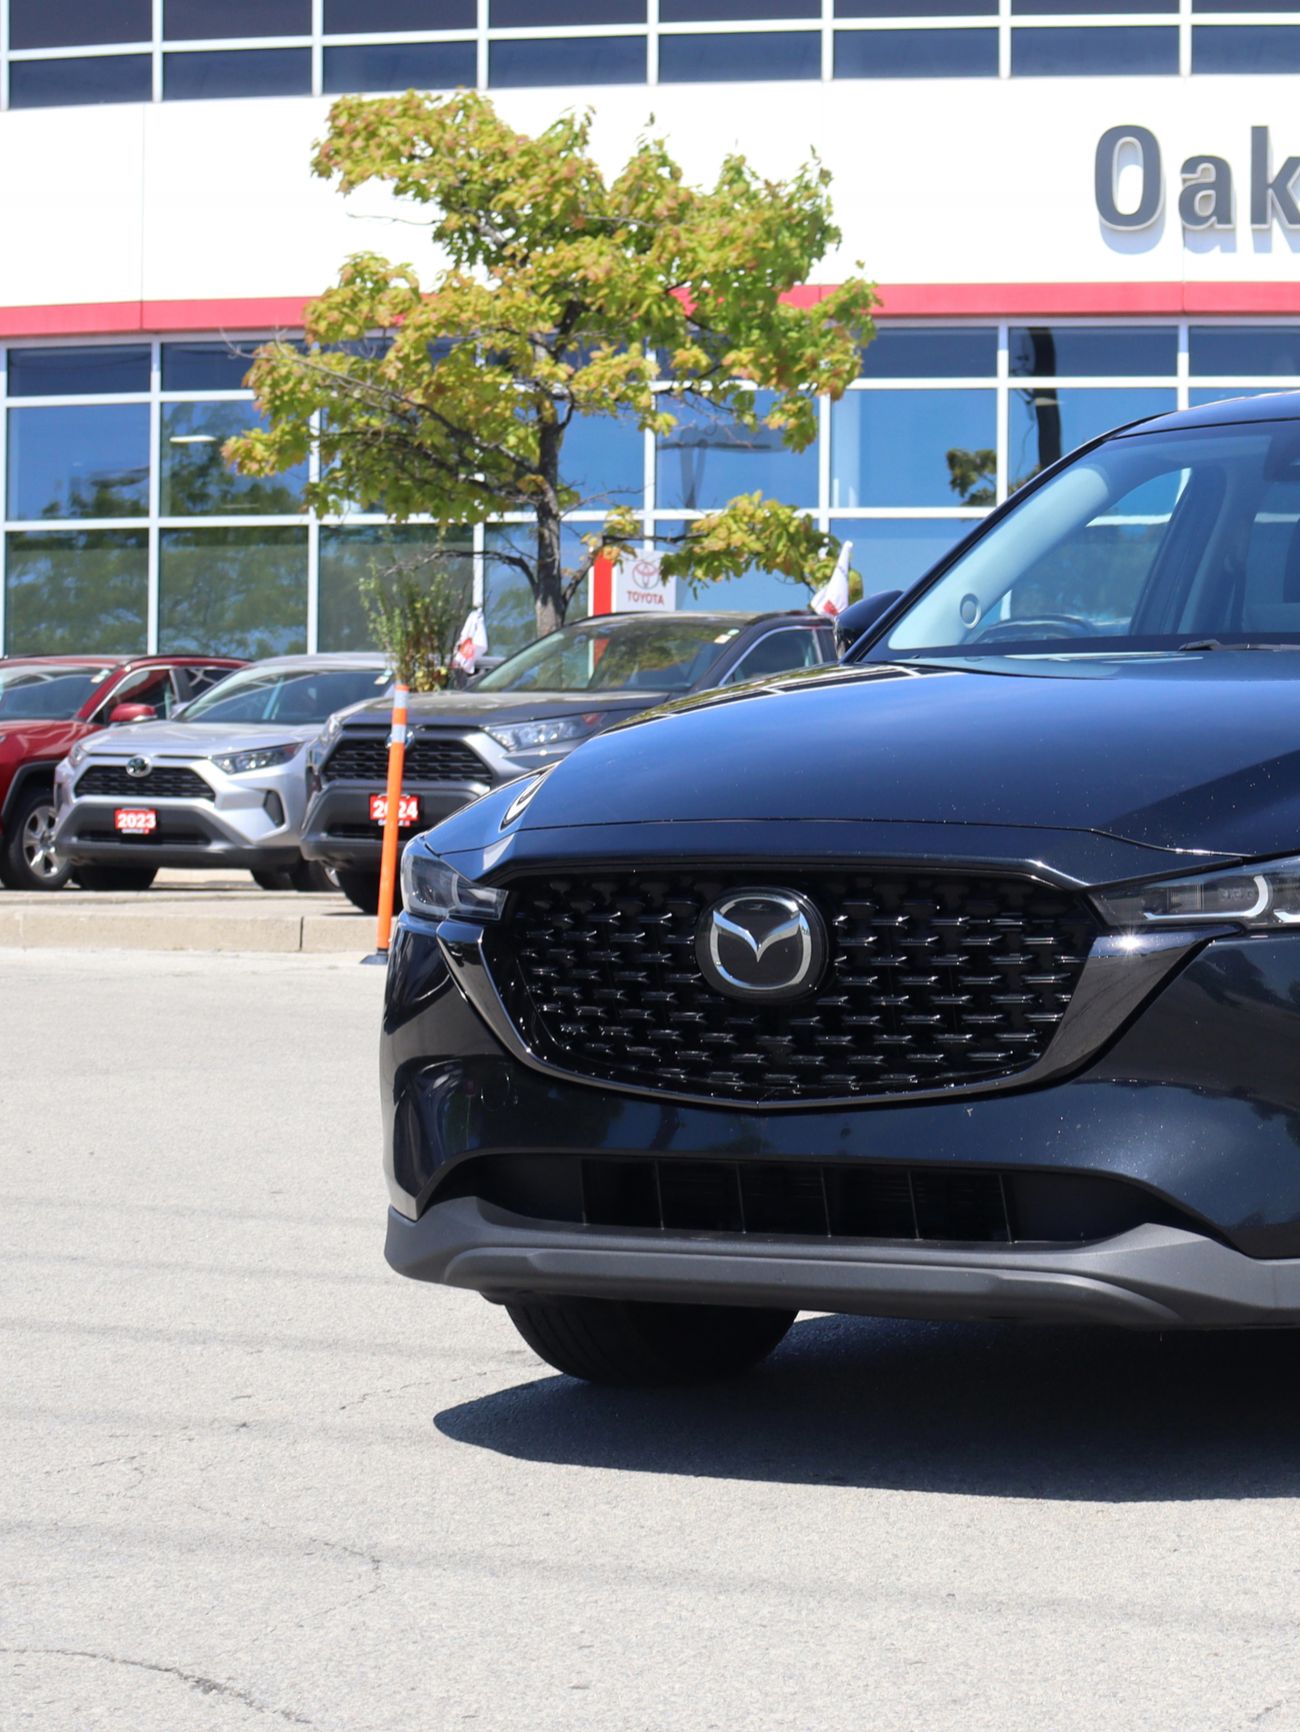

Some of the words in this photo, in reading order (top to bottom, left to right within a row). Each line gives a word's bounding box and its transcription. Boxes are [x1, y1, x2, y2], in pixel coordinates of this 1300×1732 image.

[627, 591, 664, 605] TOYOTA
[373, 800, 418, 818] 224
[118, 813, 156, 829] 2023
